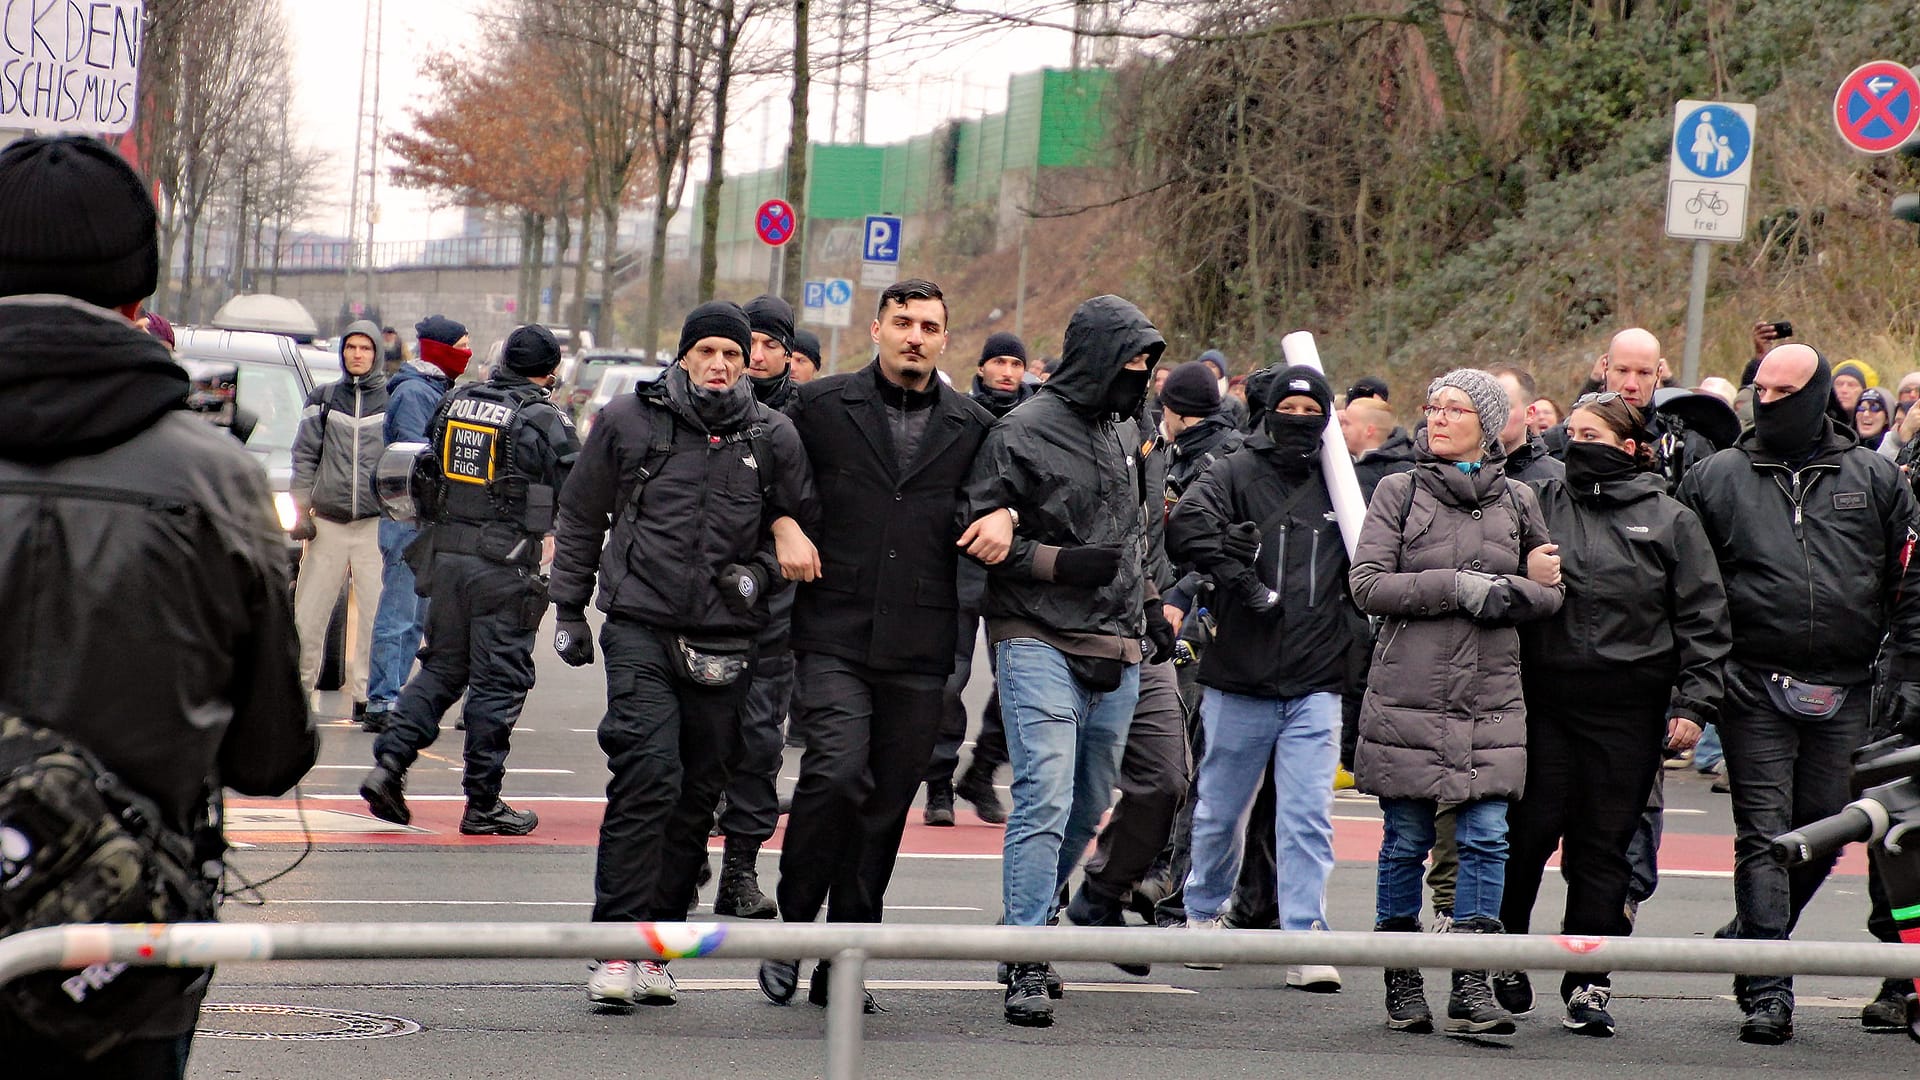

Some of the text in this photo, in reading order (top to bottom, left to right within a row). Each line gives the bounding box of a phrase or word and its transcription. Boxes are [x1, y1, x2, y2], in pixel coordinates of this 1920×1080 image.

[66, 0, 138, 69] DEN
[1694, 218, 1718, 231] frei
[868, 221, 891, 257] P
[809, 285, 821, 305] P
[447, 399, 513, 426] POLIZEI
[455, 429, 485, 447] NRW
[455, 446, 480, 459] 2 BF
[453, 460, 480, 475] FüGr
